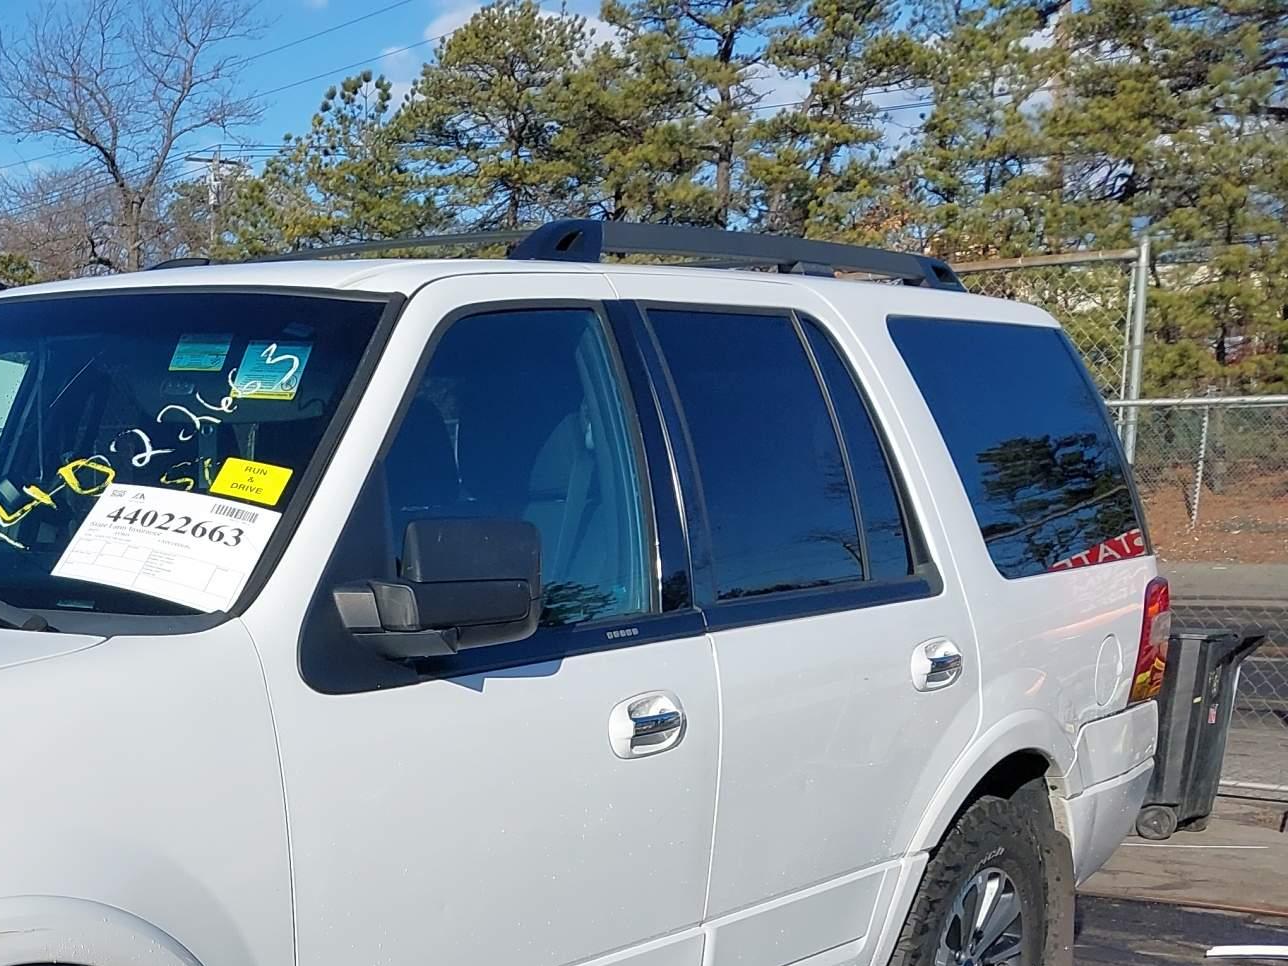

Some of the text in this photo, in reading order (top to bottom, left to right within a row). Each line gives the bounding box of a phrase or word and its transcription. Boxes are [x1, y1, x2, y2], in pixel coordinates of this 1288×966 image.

[244, 465, 268, 476] RUN
[230, 482, 264, 495] DRIVE
[106, 505, 245, 547] 44022663
